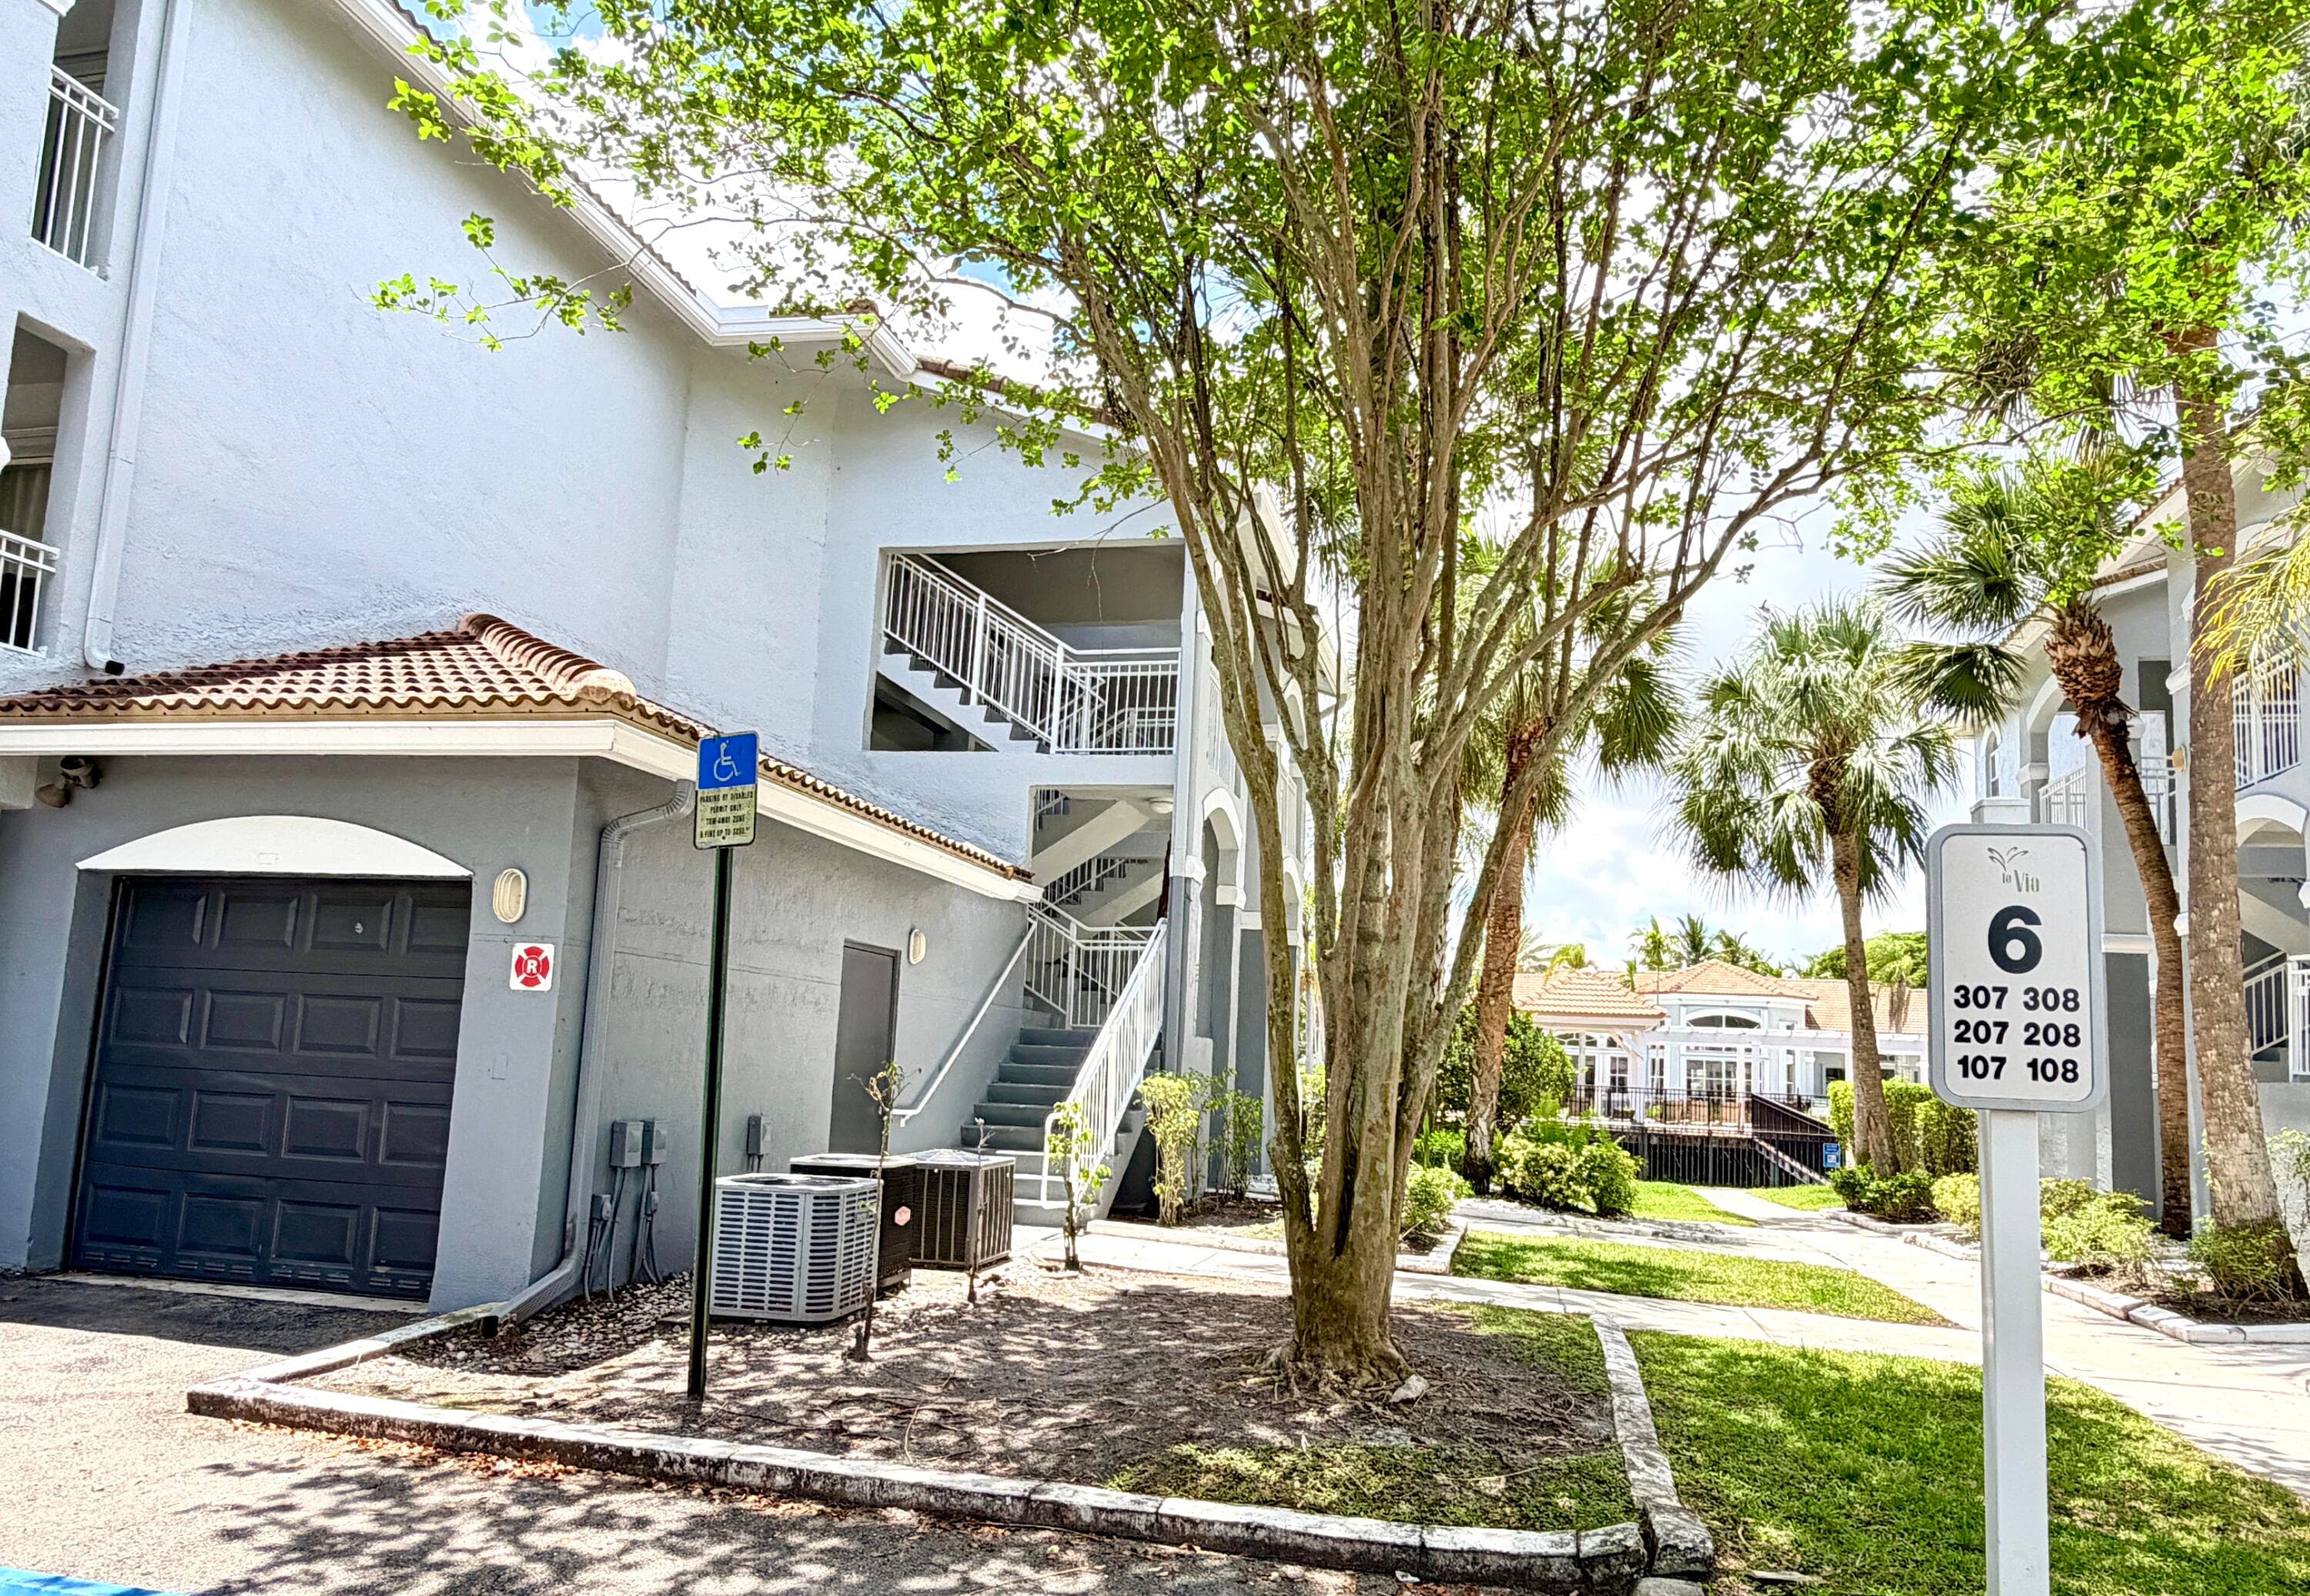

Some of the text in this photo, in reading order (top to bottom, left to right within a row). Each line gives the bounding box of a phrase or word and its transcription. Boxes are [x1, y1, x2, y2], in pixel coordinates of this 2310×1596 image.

[2014, 869, 2040, 893] Via
[1987, 905, 2043, 975] 6
[527, 959, 537, 974] R
[1953, 985, 2081, 1012] 307 308
[1953, 1019, 2081, 1048] 207 208
[1957, 1055, 2080, 1084] 107 108
